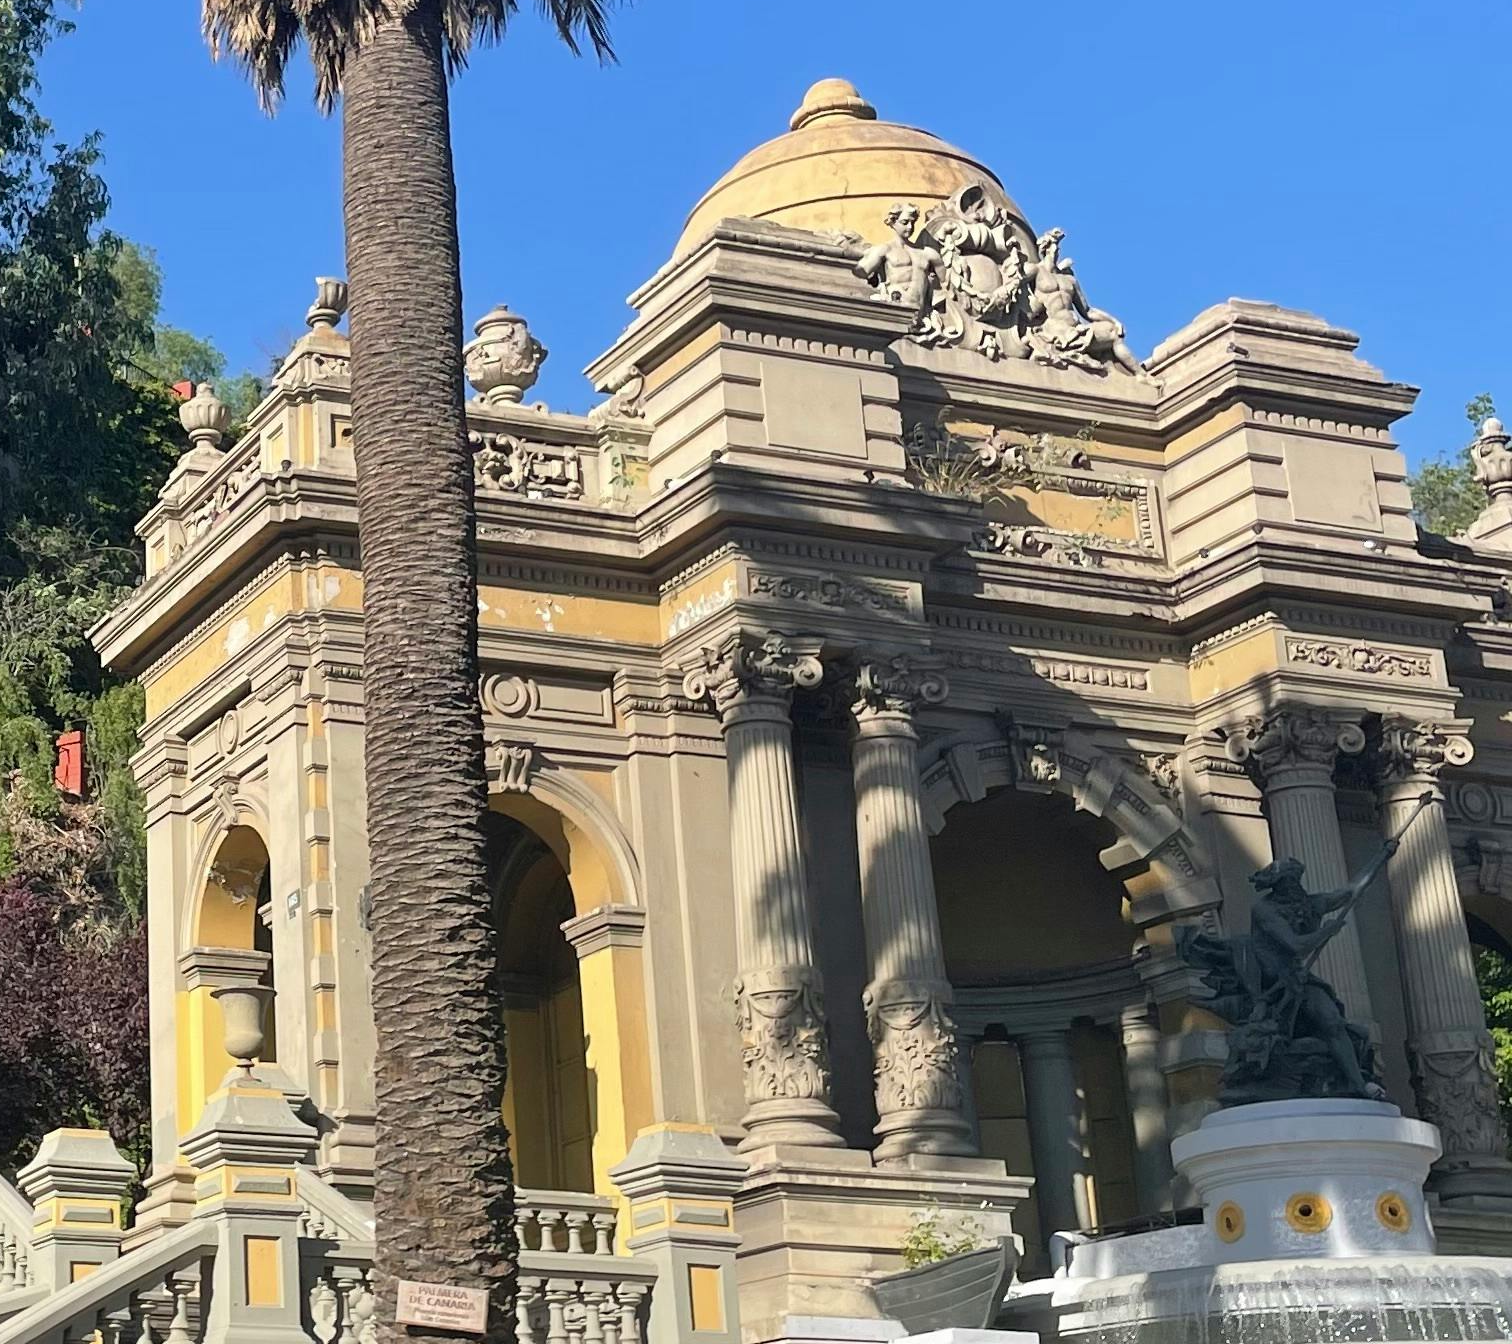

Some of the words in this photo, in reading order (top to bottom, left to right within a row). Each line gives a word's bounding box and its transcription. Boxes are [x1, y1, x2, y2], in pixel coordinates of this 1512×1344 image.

[418, 1286, 468, 1300] PALMERA
[409, 1295, 425, 1305] DE
[427, 1297, 476, 1311] CANARIA
